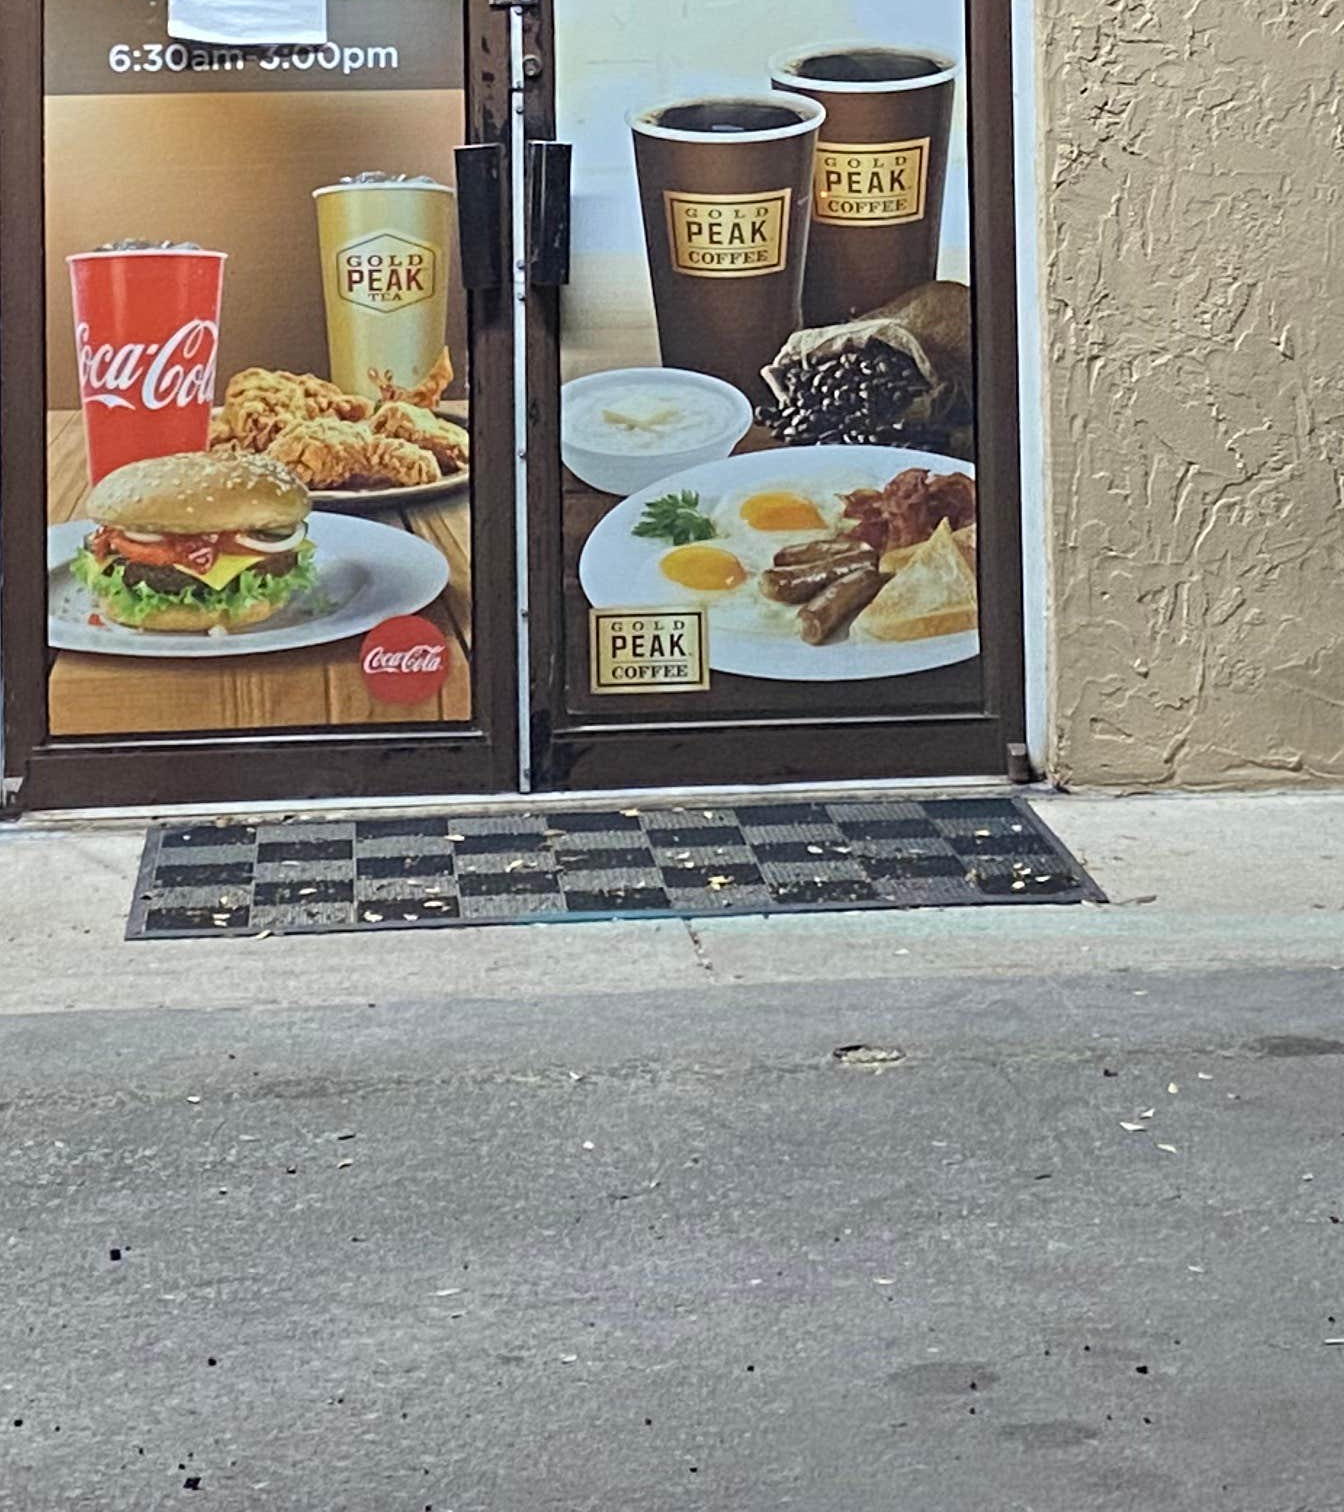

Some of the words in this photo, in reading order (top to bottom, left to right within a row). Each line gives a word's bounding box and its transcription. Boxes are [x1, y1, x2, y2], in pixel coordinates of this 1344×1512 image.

[824, 156, 907, 169] GOLD
[825, 169, 906, 194] PEAK
[685, 207, 768, 219] GOLD
[827, 199, 908, 213] COFFEE
[686, 220, 767, 245] PEAK
[347, 254, 423, 267] GOLD
[688, 249, 768, 265] COFFEE
[348, 268, 424, 292] PEAK
[368, 293, 402, 302] TEA
[611, 620, 685, 632] GOLD
[611, 633, 687, 659] PEAK
[363, 644, 445, 674] Coca-Cola
[611, 664, 688, 679] COFFEE
